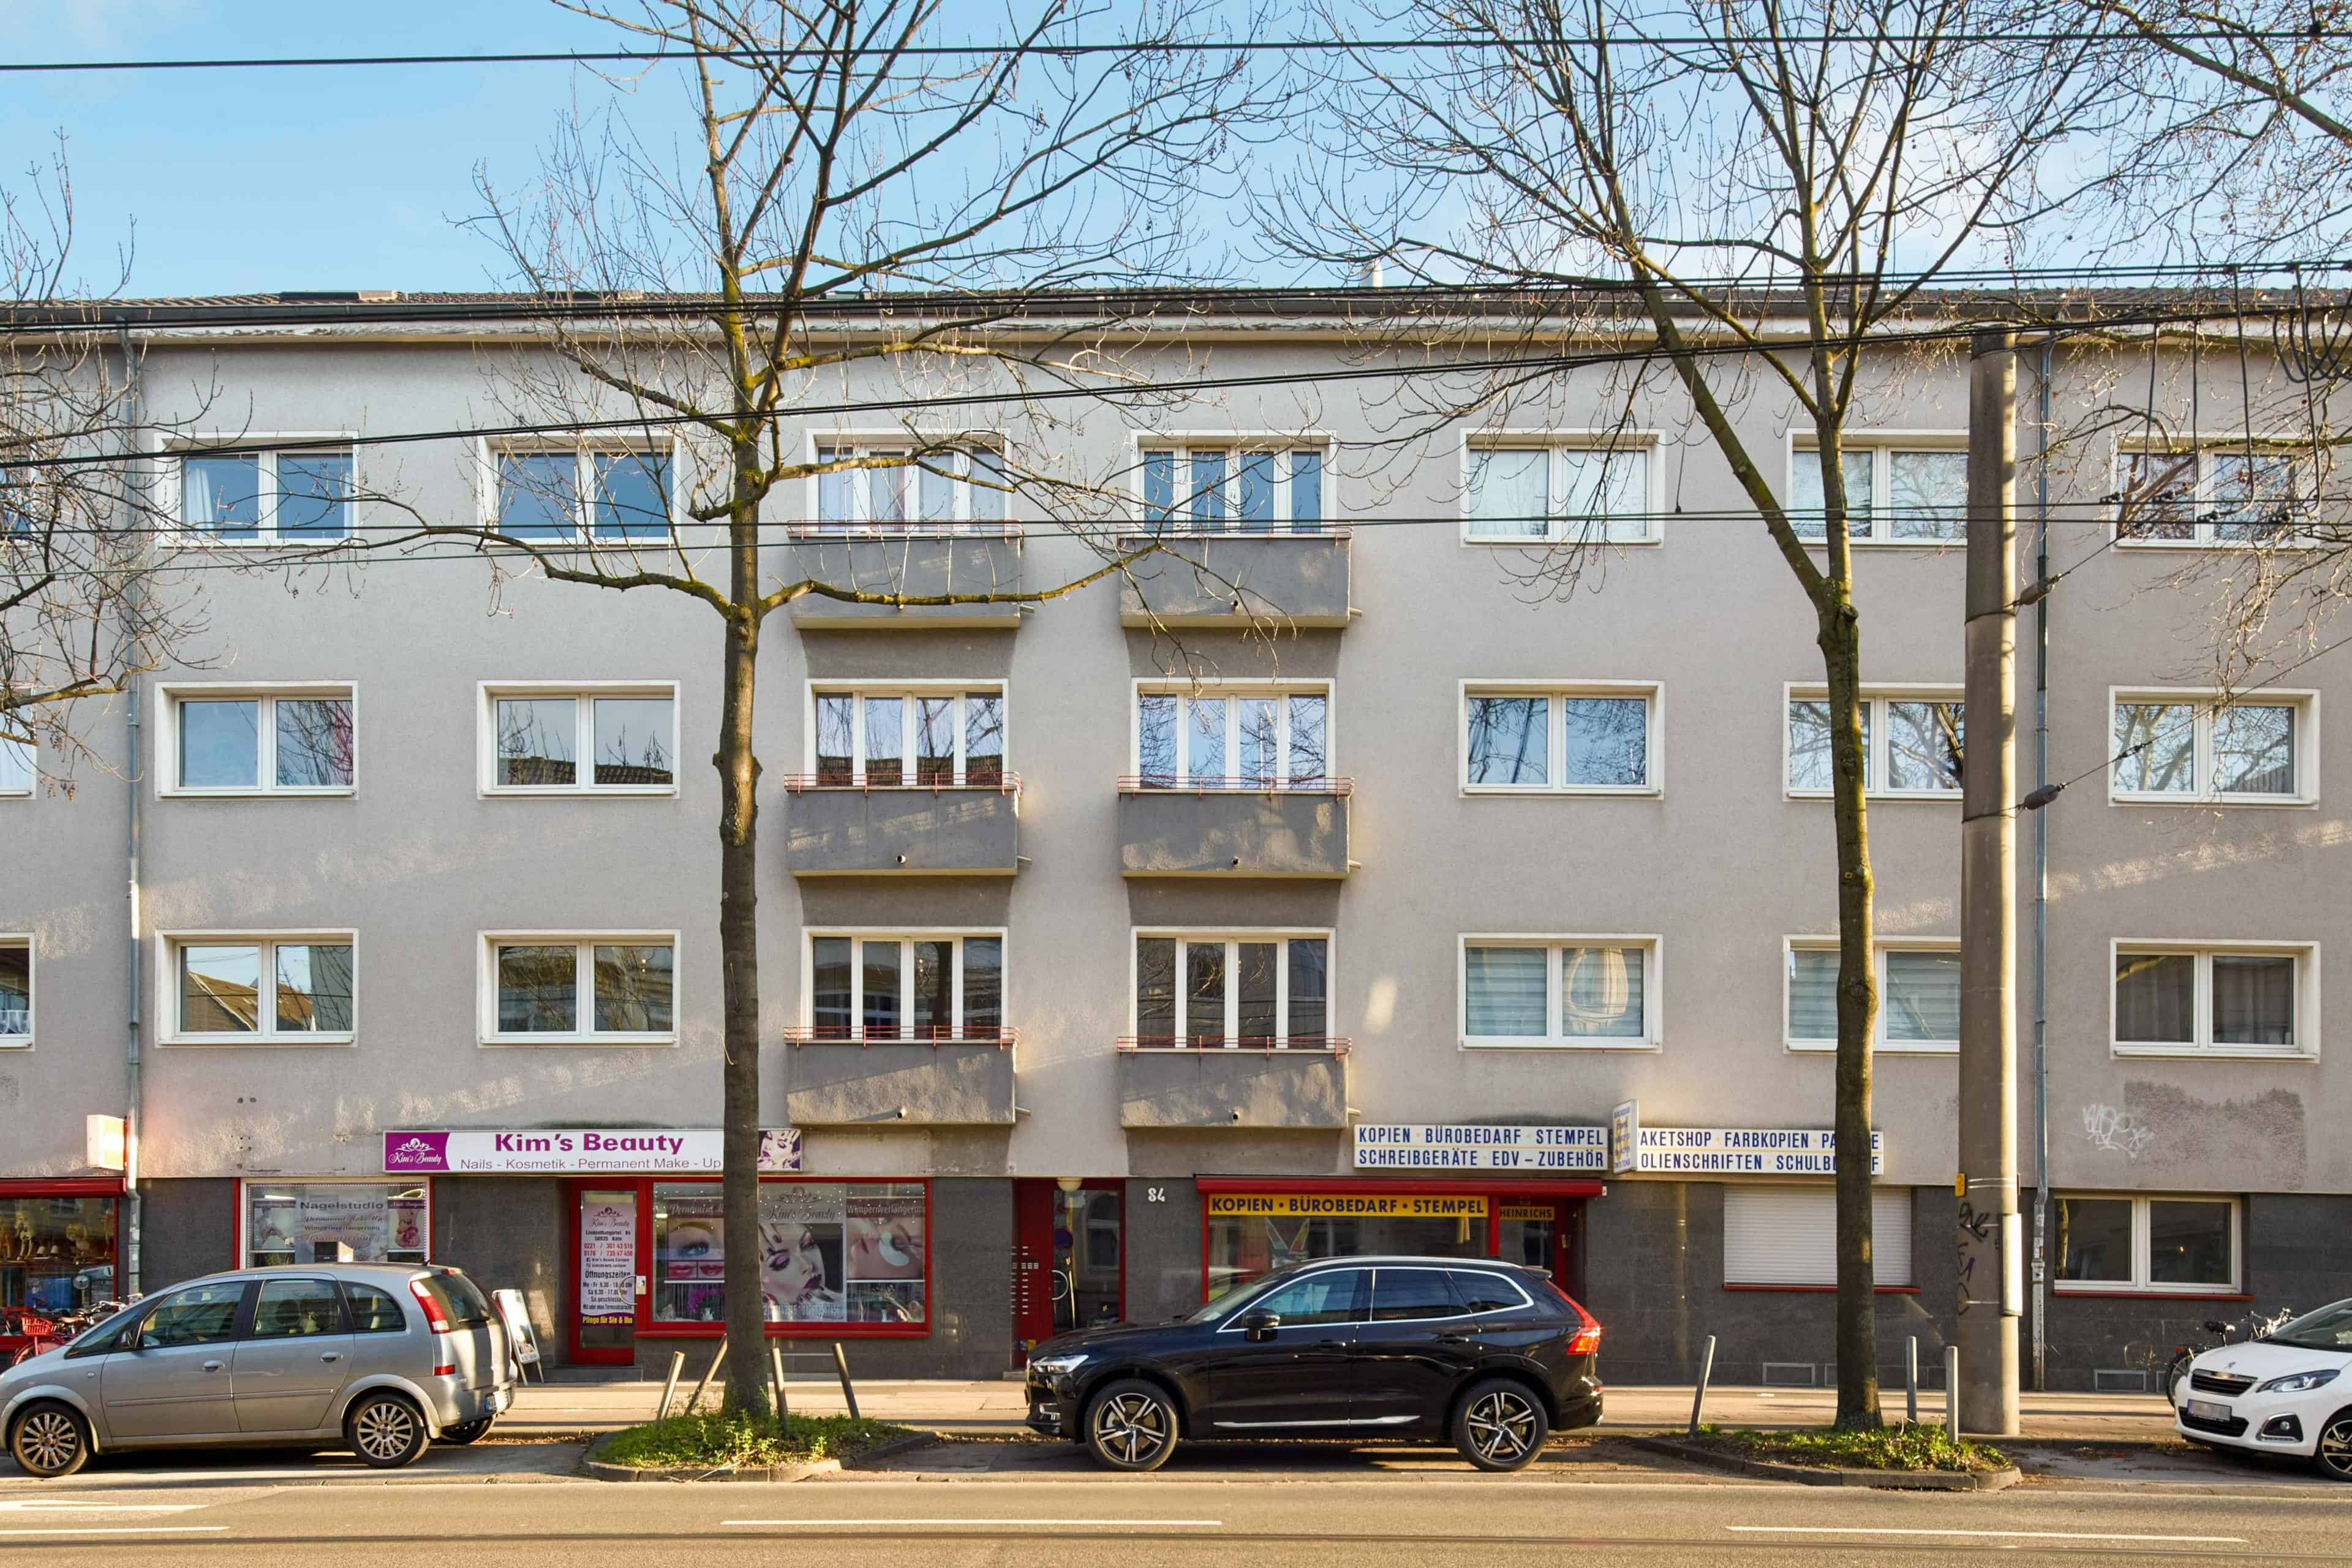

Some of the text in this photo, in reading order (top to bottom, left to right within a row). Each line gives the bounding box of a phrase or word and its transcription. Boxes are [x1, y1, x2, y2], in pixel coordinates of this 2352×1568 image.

[1359, 1127, 1411, 1143] KOPIEN
[1425, 1125, 1521, 1144] BÜROBEDARF
[1536, 1129, 1604, 1145] STEMPEL
[1640, 1131, 1711, 1147] AKETSHOP
[1724, 1131, 1809, 1148] FARBKOPIEN
[583, 1133, 684, 1155] Beauty
[414, 1152, 442, 1165] Beauty
[461, 1158, 492, 1169] Nails
[506, 1158, 565, 1169] Kosmetik
[578, 1158, 650, 1169] Permanent
[654, 1158, 690, 1169] Make
[703, 1158, 722, 1170] Up
[1359, 1147, 1478, 1166] SCHREIBGERÄTE
[1492, 1150, 1520, 1166] EDV
[1538, 1148, 1604, 1167] ZUBEHÖR
[1641, 1153, 1762, 1170] OLIENSCHRIFTEN
[1147, 1187, 1166, 1202] 84
[300, 1201, 384, 1211] Nagelstudio
[1212, 1195, 1484, 1213] KOPIEN BÜROBEDARF STEMPEL
[1499, 1208, 1552, 1218] HEINRICHS
